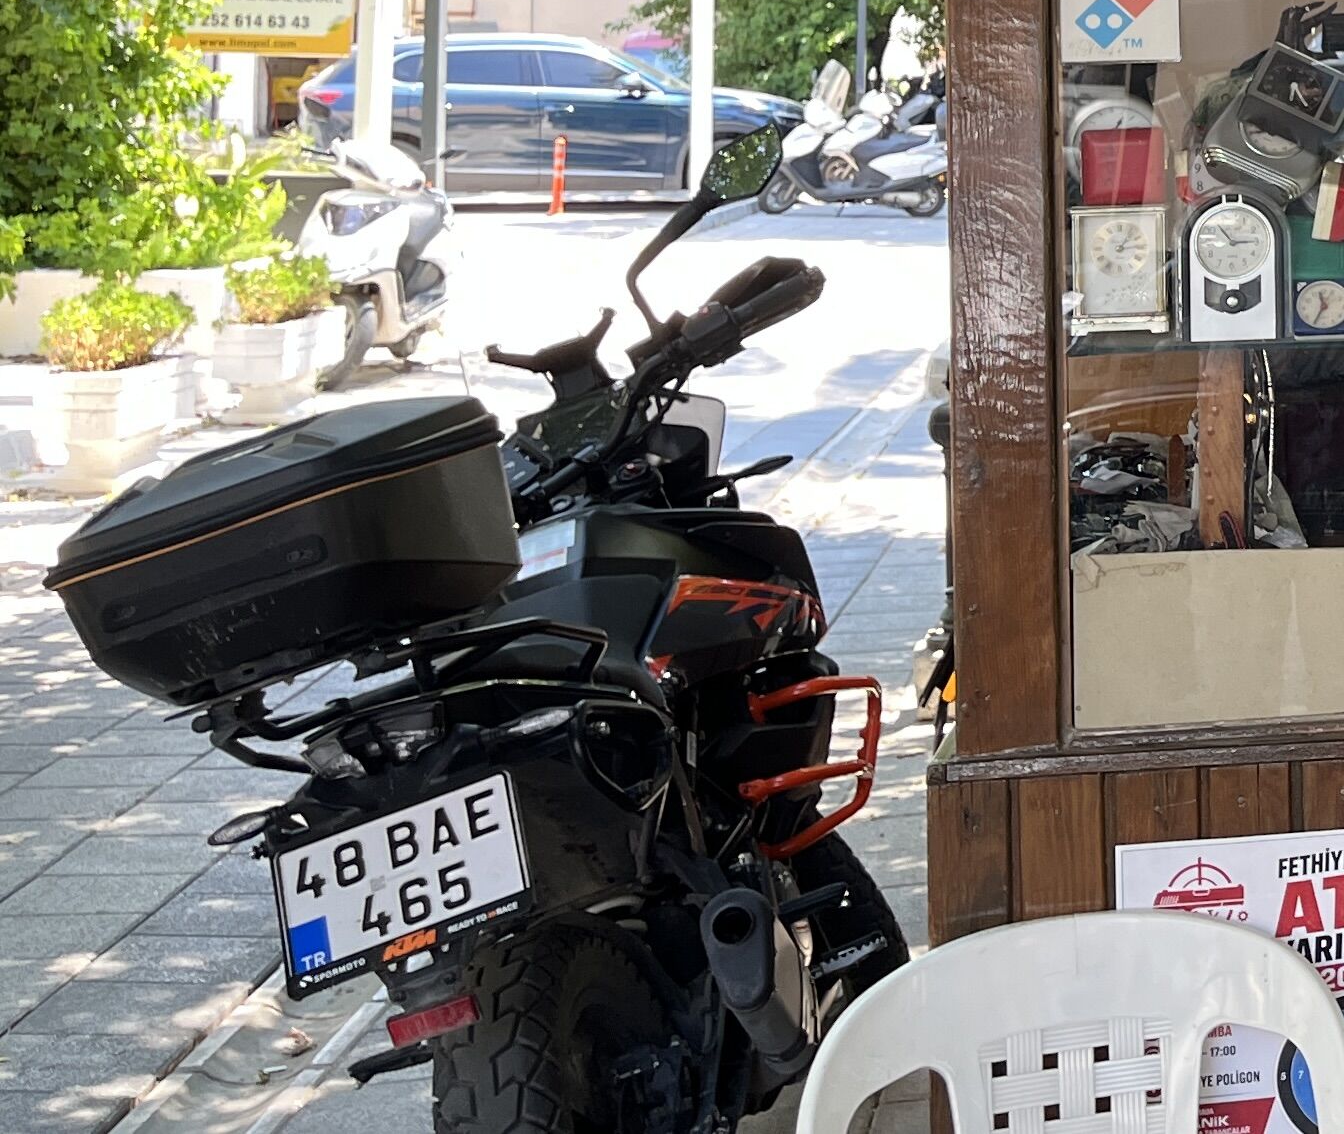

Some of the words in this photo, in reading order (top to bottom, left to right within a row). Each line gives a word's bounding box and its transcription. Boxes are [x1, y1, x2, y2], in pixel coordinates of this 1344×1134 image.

[235, 14, 262, 28] 614
[268, 15, 286, 28] 63
[291, 16, 310, 29] 43
[1124, 38, 1142, 48] TM
[296, 840, 367, 899] 48
[386, 789, 500, 870] BAE
[362, 860, 472, 938] 465
[447, 918, 475, 933] READY
[382, 929, 437, 963] KTM
[301, 951, 326, 971] TR
[313, 958, 367, 984] SPORMOTO
[1216, 1070, 1260, 1086] POLİGON
